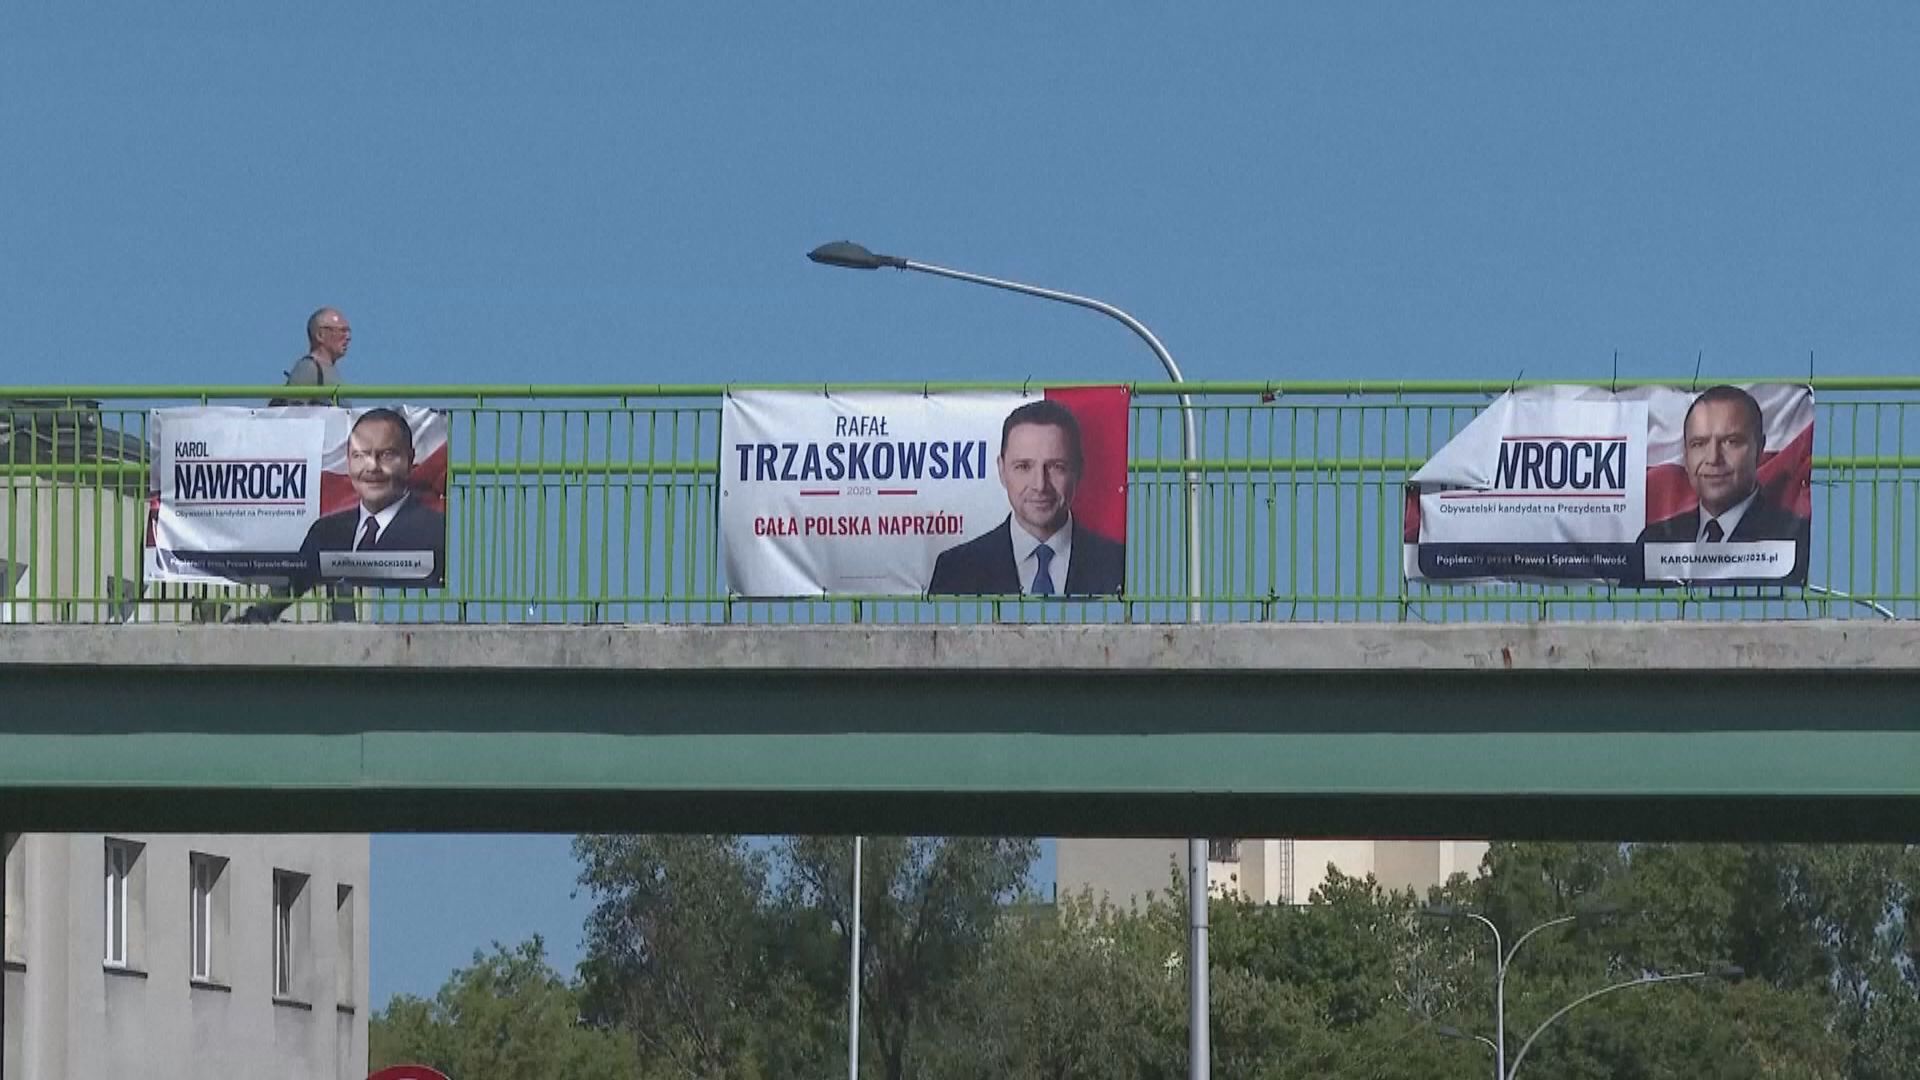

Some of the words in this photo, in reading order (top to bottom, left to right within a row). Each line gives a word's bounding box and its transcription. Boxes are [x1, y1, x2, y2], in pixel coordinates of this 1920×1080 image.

[835, 415, 889, 437] RAFAŁ
[175, 441, 209, 458] KAROL
[735, 440, 987, 482] TRZASKOWSKI
[1440, 441, 1627, 491] WROCKI
[174, 463, 307, 500] NAWROCKI
[846, 486, 872, 496] 2025
[1439, 503, 1497, 515] Obywatelski
[1498, 503, 1542, 515] kandydat
[1544, 505, 1555, 513] na
[1557, 503, 1611, 515] Prezydenta
[1613, 504, 1627, 513] RP
[754, 515, 798, 536] CAŁA
[804, 514, 872, 536] POLSKA
[877, 510, 964, 536] NAPRZÓD!
[1514, 554, 1545, 565] Prawo
